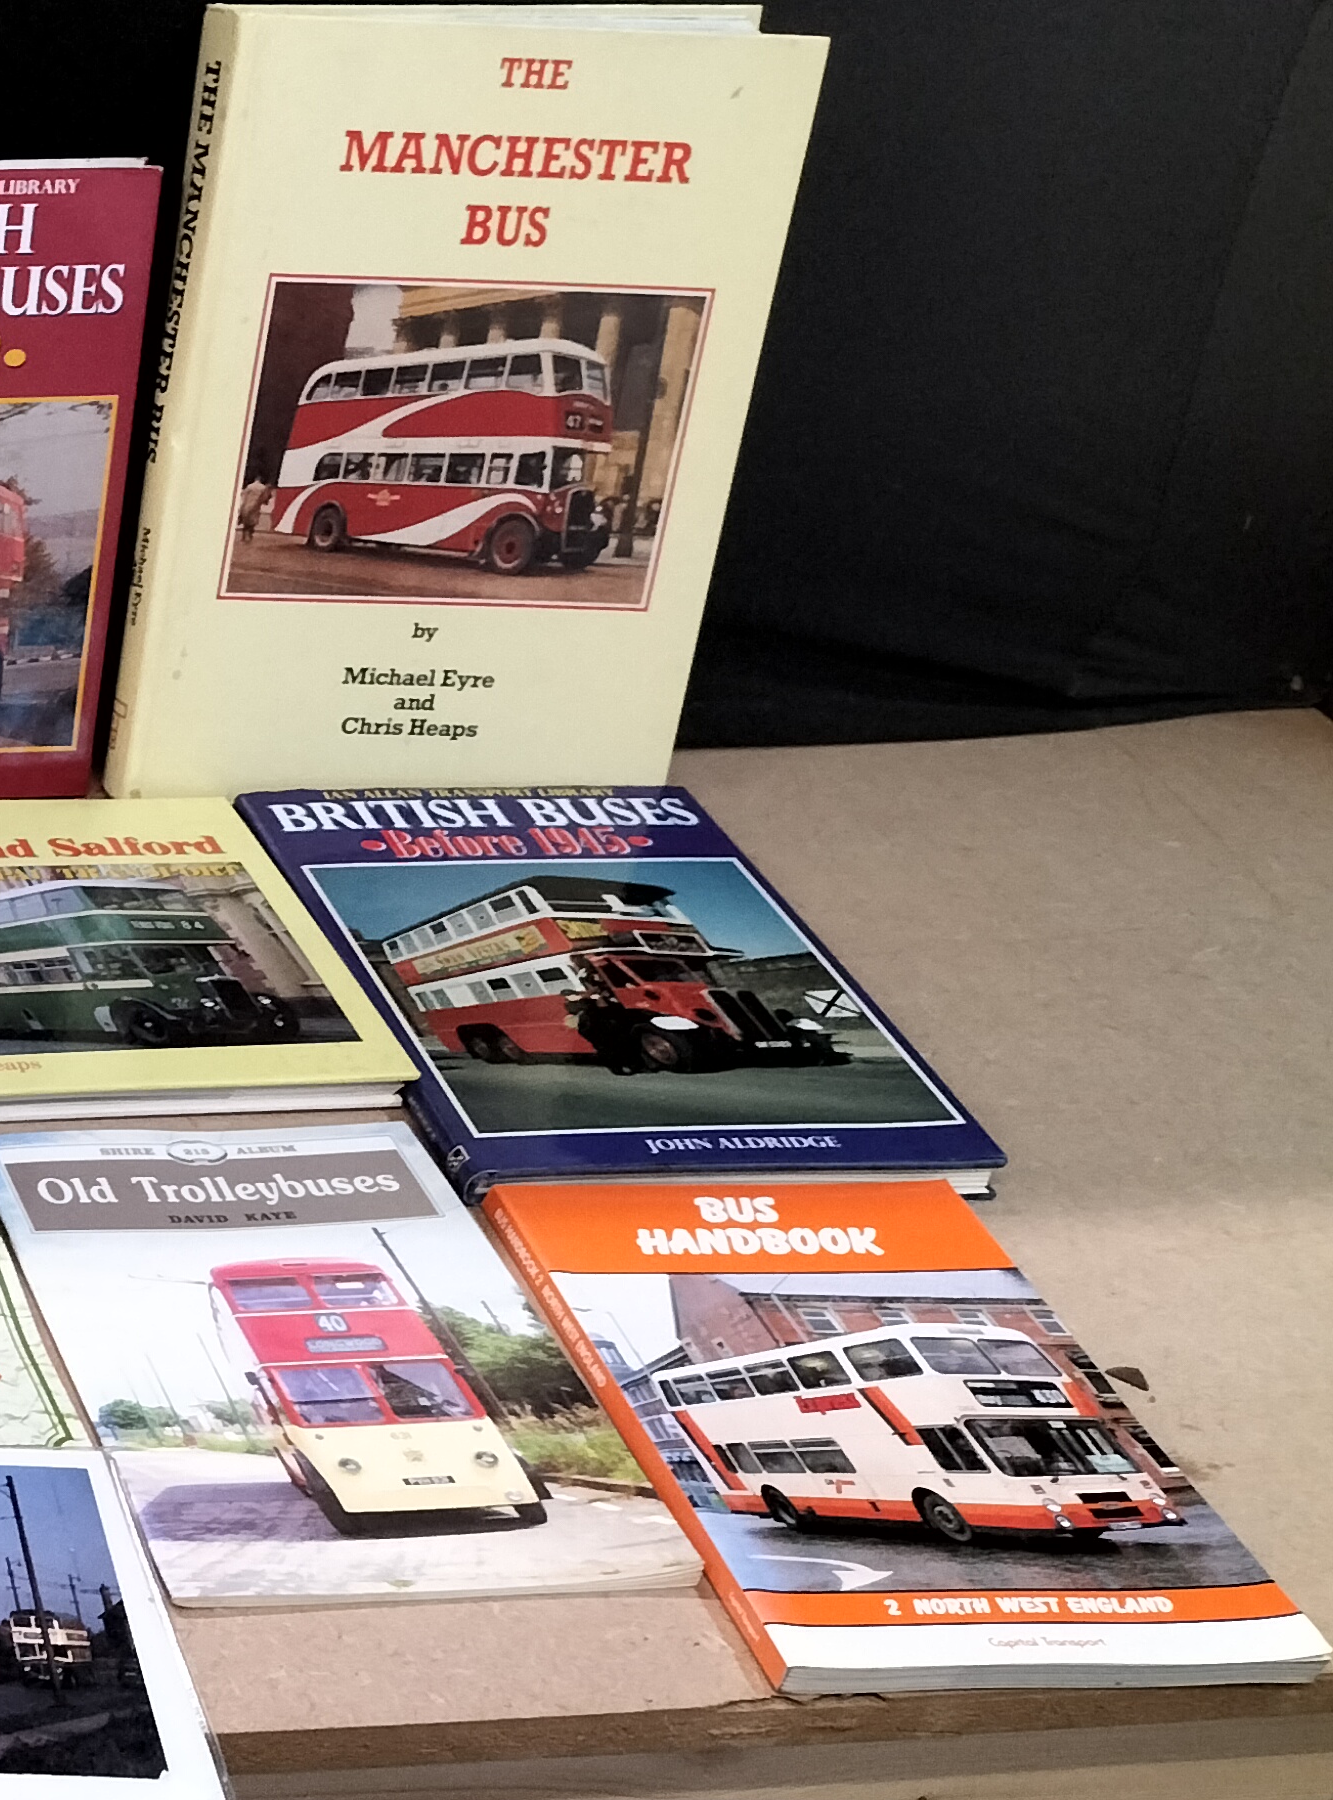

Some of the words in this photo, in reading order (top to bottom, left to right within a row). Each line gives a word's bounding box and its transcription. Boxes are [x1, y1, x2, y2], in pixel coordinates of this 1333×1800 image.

[499, 57, 573, 91] THE
[197, 60, 222, 136] THE
[339, 130, 694, 185] MANCHESTER
[459, 205, 552, 248] BUS
[155, 143, 210, 396] MANCHESTER
[411, 622, 438, 643] by
[342, 666, 436, 688] Michael
[440, 669, 495, 692] Eyre
[393, 694, 435, 712] and
[341, 716, 404, 738] Chris
[407, 718, 478, 740] Heaps
[323, 789, 357, 800] IAN
[363, 788, 423, 799] ALLAN
[429, 787, 533, 798] TRANSPORT
[536, 786, 613, 797] LIBRARY
[268, 798, 513, 832] BRITISH
[527, 797, 701, 828] BUSES
[47, 836, 226, 858] Salford
[380, 828, 528, 860] Before
[533, 828, 633, 857] 1945
[100, 1147, 155, 1156] SHIRE
[236, 1145, 298, 1154] ALBUM
[644, 1137, 713, 1155] JOHN
[719, 1134, 842, 1150] ALDRIDGE
[37, 1176, 119, 1205] Old
[131, 1173, 400, 1205] Trolleybuses
[168, 1214, 229, 1224] DAVID
[244, 1211, 297, 1222] KAYE
[694, 1196, 779, 1224] BUS
[636, 1227, 886, 1256] HANDBOOK
[318, 1314, 348, 1332] 40
[884, 1599, 901, 1616] 2
[914, 1598, 991, 1616] NORTH
[996, 1596, 1059, 1615] WEST
[1067, 1595, 1174, 1615] ENGLAND
